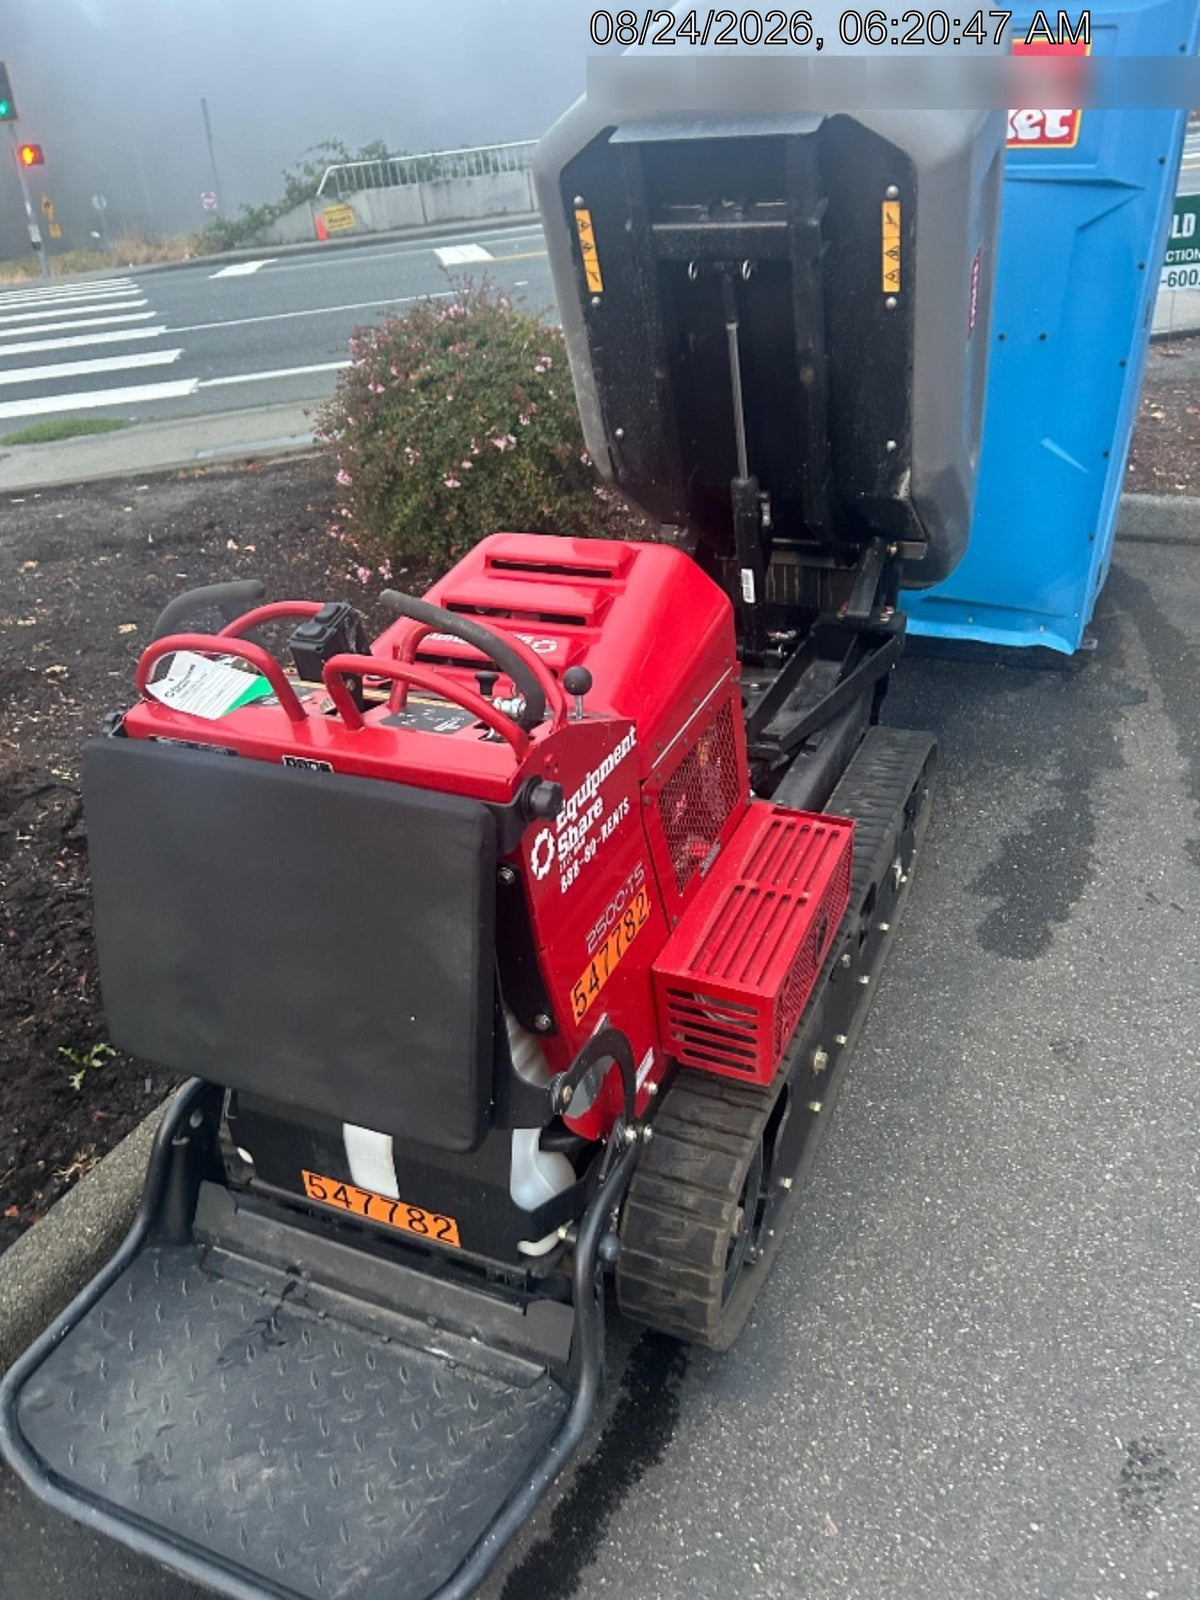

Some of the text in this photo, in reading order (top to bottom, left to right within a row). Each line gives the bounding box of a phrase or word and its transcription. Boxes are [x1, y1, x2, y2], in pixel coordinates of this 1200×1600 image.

[558, 796, 603, 862] Share
[573, 891, 648, 1017] 547782
[307, 1176, 454, 1243] 547782
